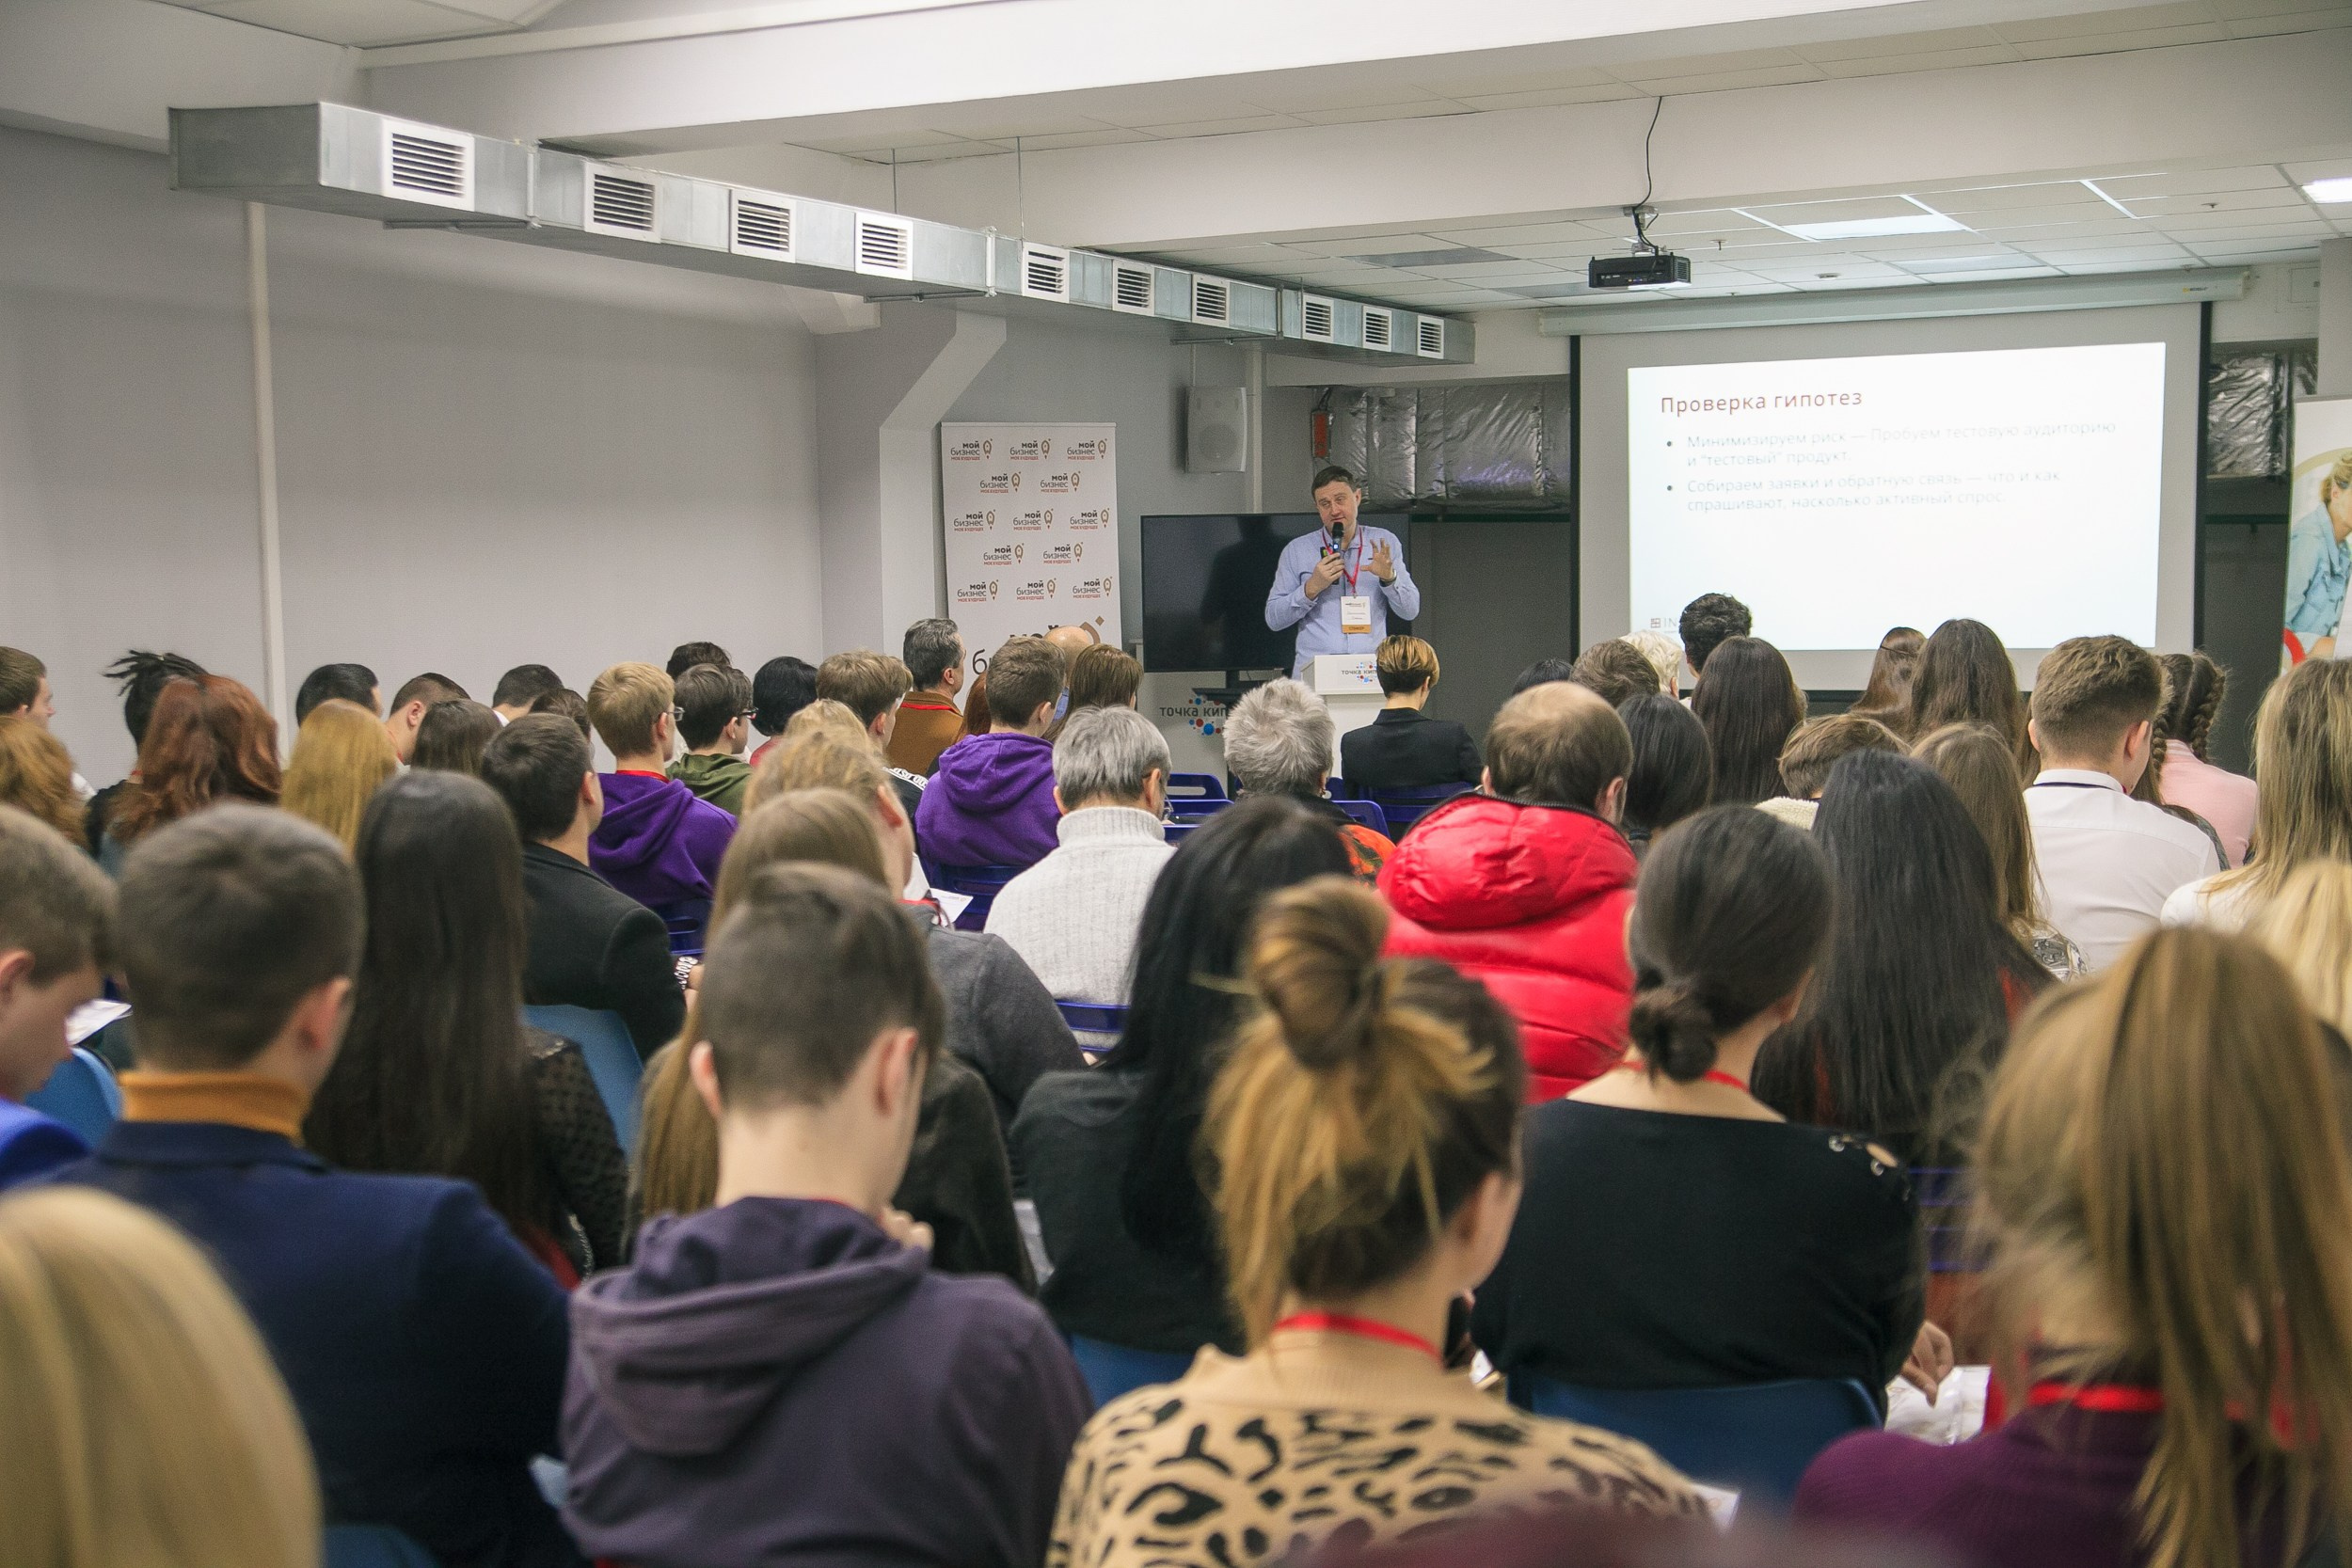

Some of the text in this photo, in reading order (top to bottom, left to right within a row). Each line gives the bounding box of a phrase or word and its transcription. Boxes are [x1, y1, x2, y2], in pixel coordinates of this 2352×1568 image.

[1661, 391, 1863, 418] Проверка гипотез
[1687, 433, 1806, 450] Минимизируем
[1811, 431, 1846, 445] риск
[2024, 422, 2116, 438] аудиторию
[1010, 447, 1039, 455] бизнес
[1067, 447, 1095, 455] бизнес
[1687, 456, 1696, 467] и
[980, 480, 1008, 488] бизнес
[1041, 480, 1068, 488] бизнес
[1687, 479, 1763, 495] Собираем
[1769, 477, 1820, 489] заявки
[1823, 477, 1834, 487] и
[1987, 473, 2014, 483] что
[2033, 470, 2061, 482] как
[1791, 496, 1871, 508] насколько
[1876, 490, 1953, 505] активный
[954, 518, 983, 527] бизнес
[1070, 516, 1098, 525] бизнес
[994, 545, 1011, 553] мой
[983, 552, 1011, 561] бизнес
[970, 581, 986, 590] мой
[958, 589, 986, 597] бизнес
[1016, 587, 1044, 595] бизнес
[1159, 706, 1200, 717] точка
